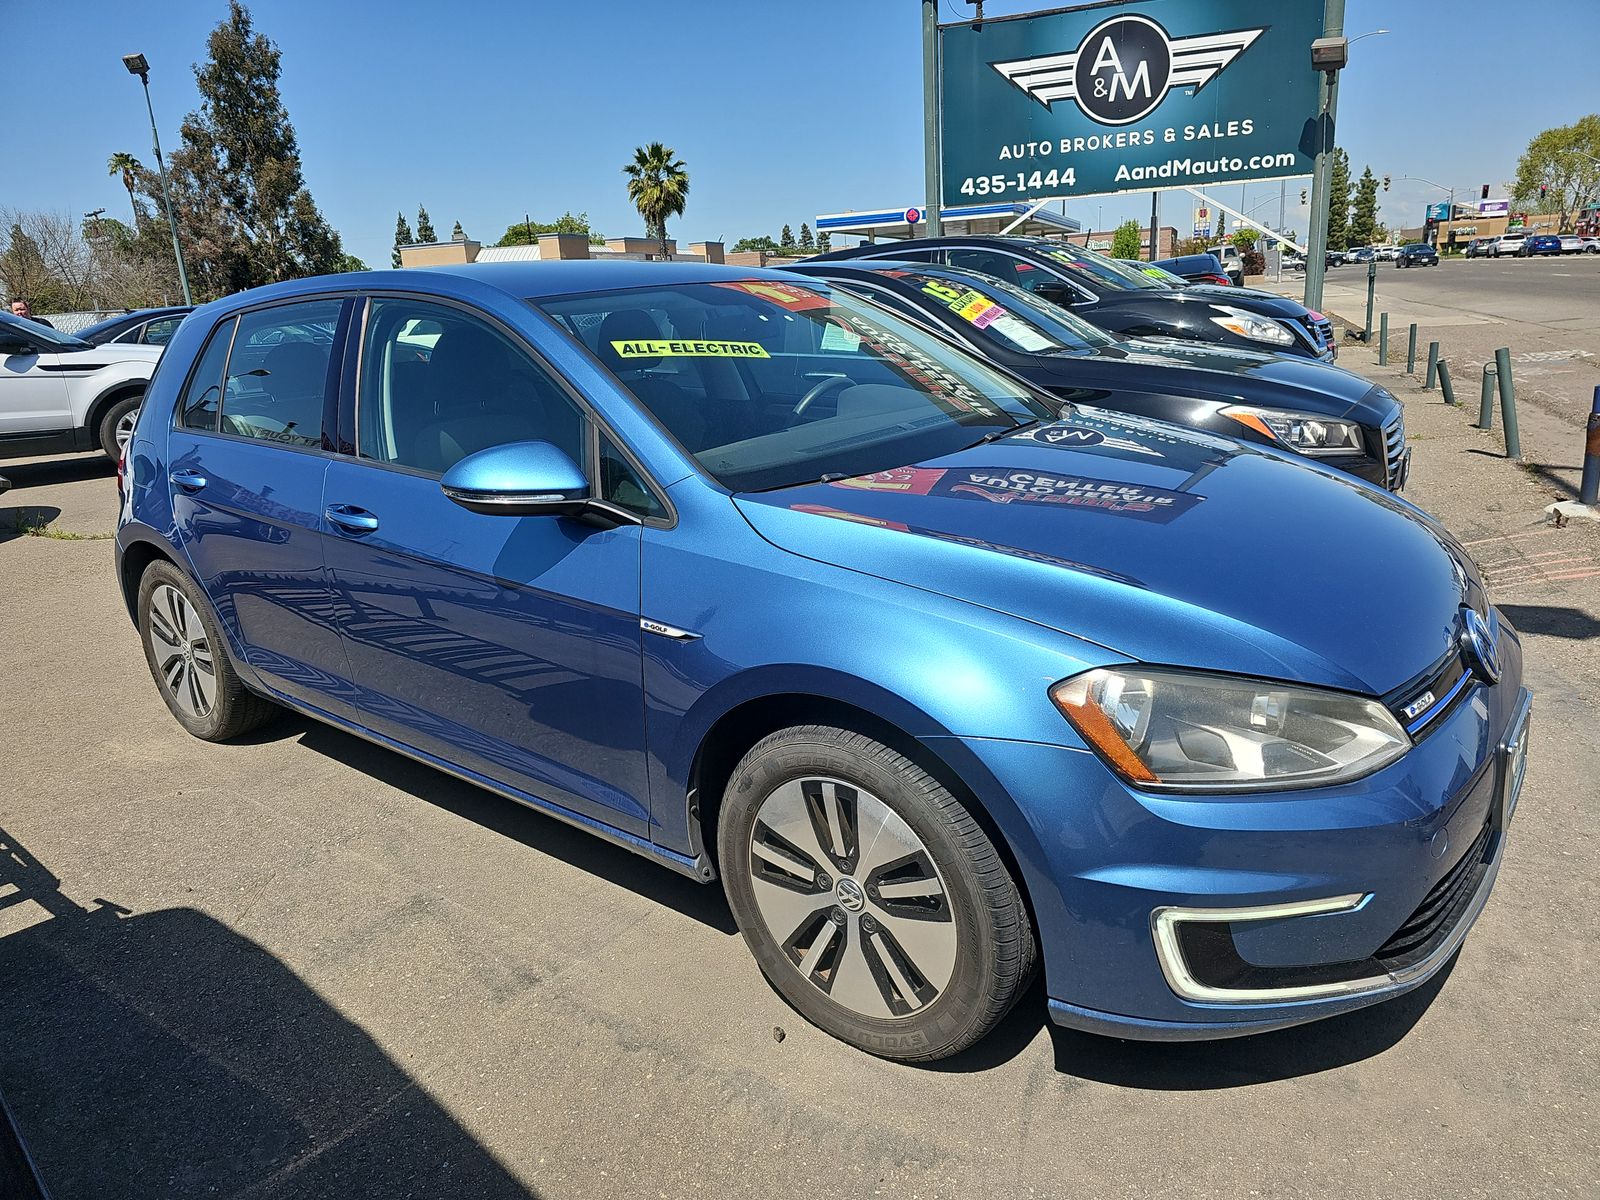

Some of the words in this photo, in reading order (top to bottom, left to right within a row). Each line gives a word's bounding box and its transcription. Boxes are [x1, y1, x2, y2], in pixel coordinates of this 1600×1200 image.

[998, 141, 1053, 160] AUTO
[1060, 130, 1155, 153] BROKERS
[1163, 128, 1176, 143] &
[1183, 119, 1254, 141] SALES
[960, 167, 1076, 196] 435-1444
[1114, 153, 1296, 182] AandMauto.com
[921, 281, 960, 304] 15
[950, 293, 978, 312] LUXURY
[622, 342, 761, 355] ALL-ELECTRIC
